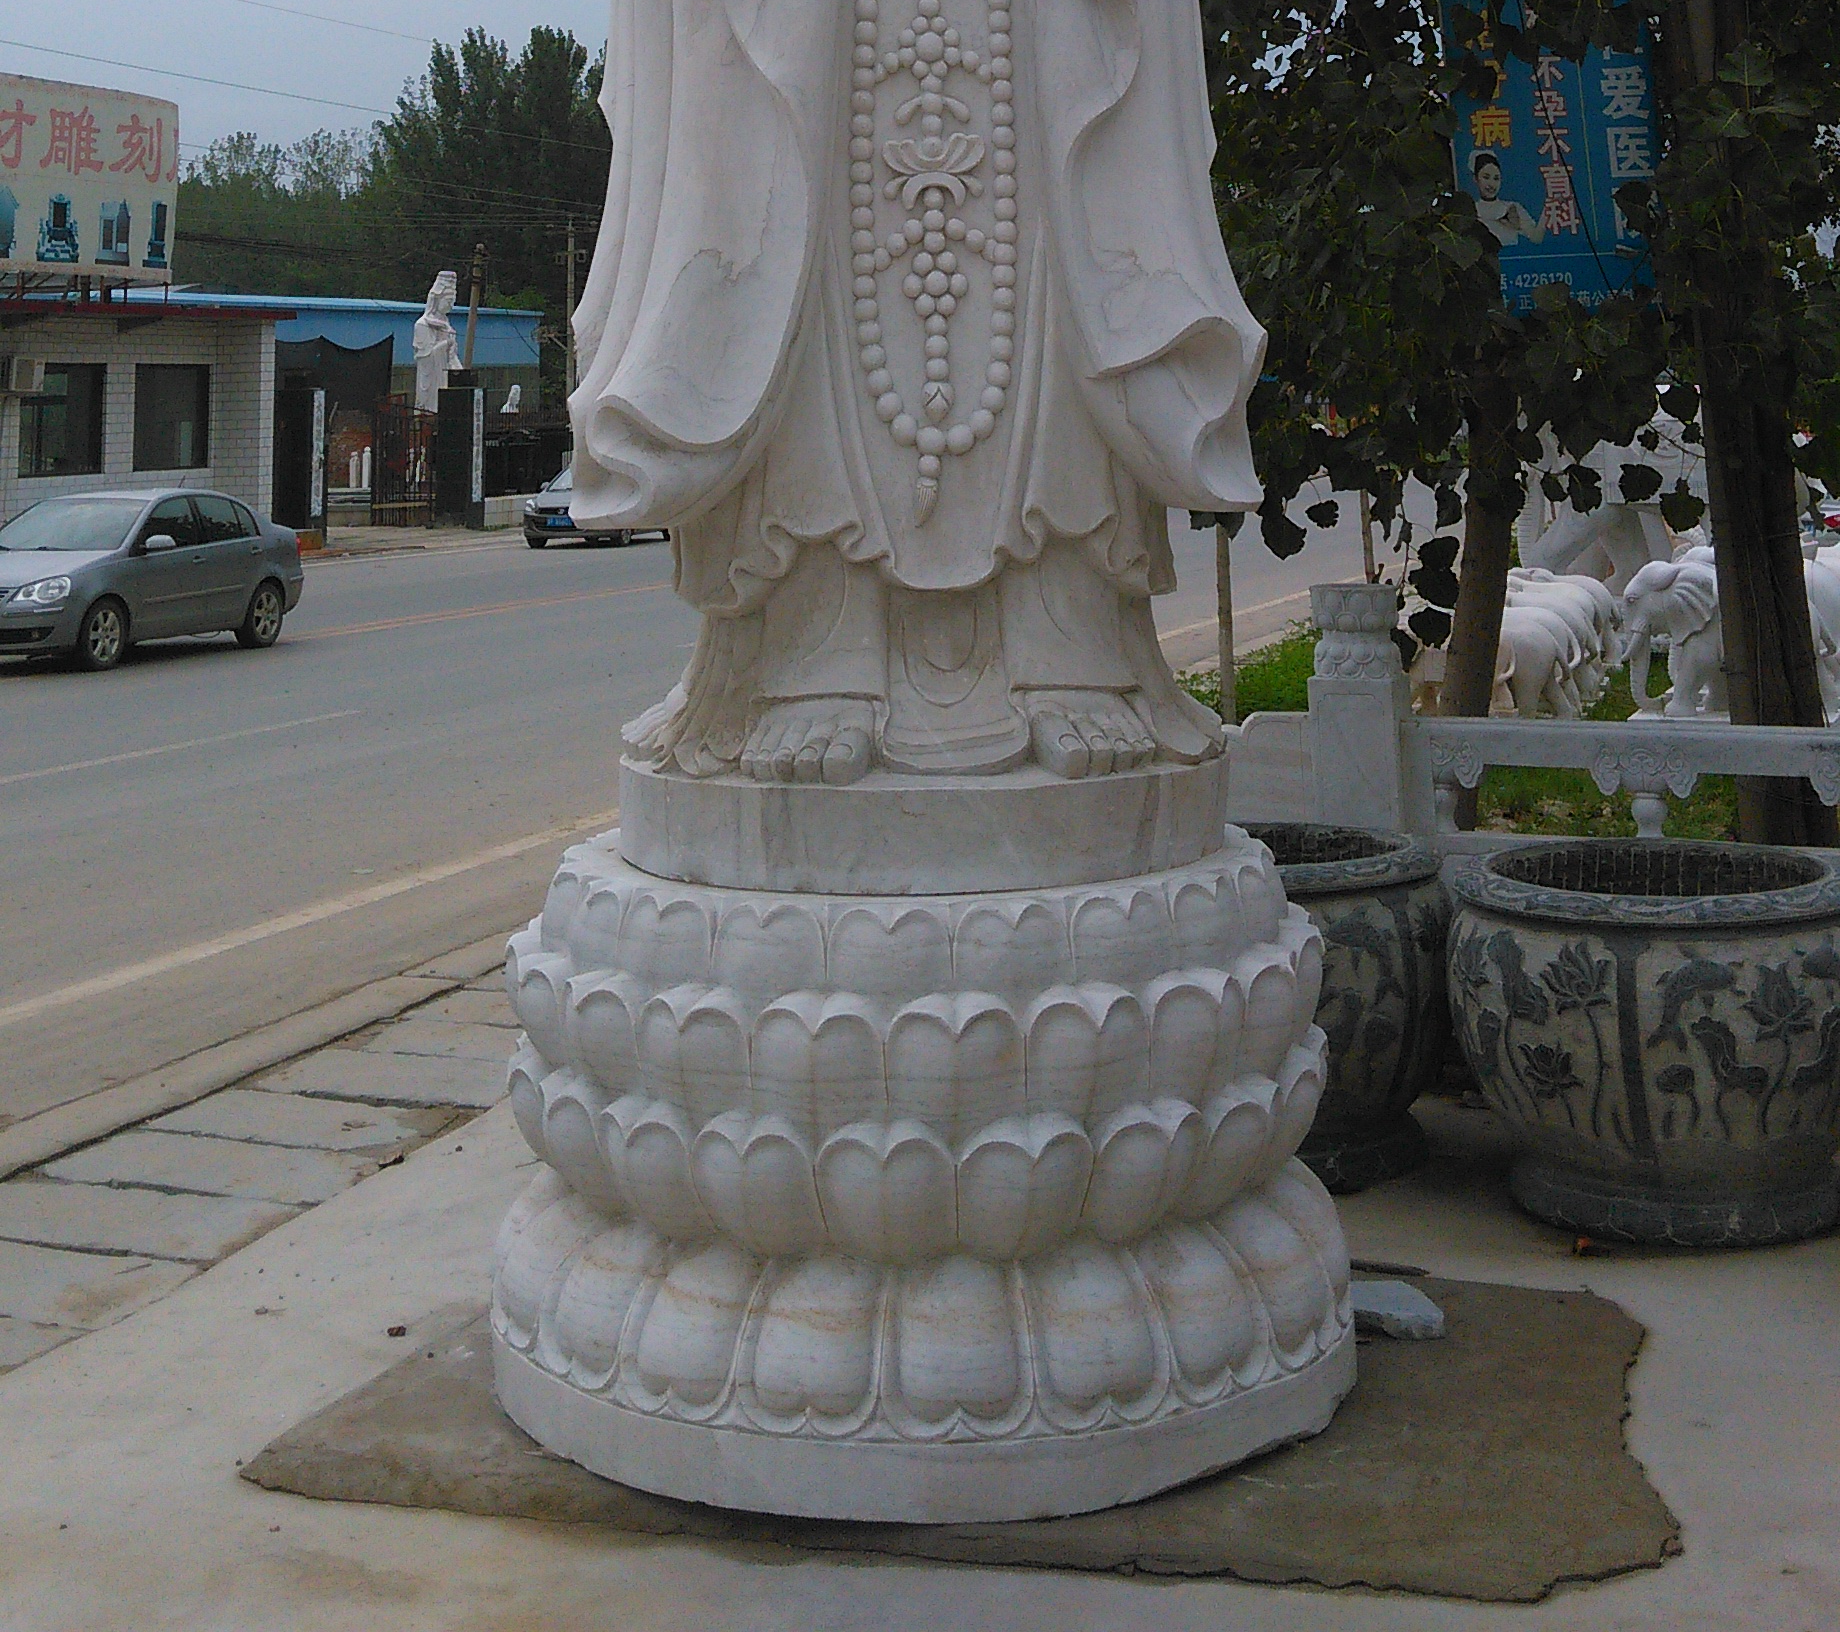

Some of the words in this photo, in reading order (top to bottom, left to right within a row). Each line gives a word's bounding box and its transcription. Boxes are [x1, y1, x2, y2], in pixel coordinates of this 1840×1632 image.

[1530, 54, 1581, 236] 不孕不育科
